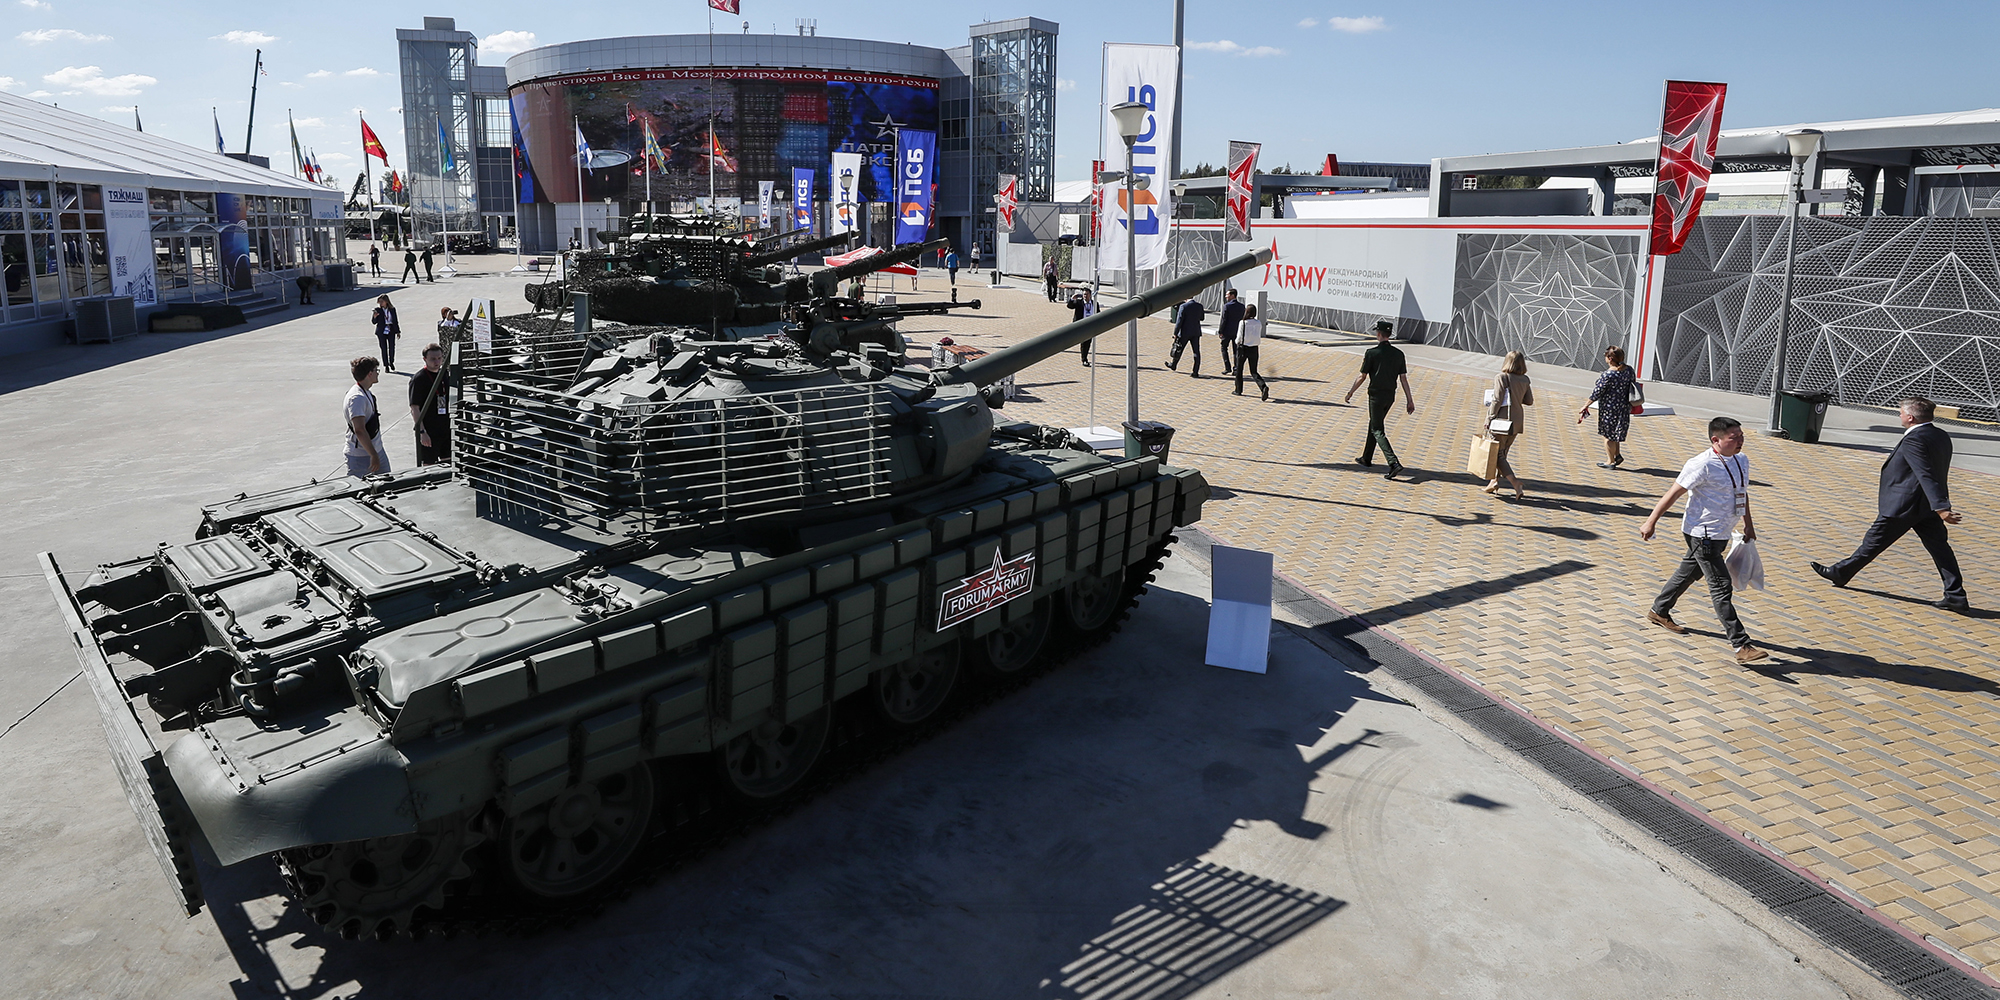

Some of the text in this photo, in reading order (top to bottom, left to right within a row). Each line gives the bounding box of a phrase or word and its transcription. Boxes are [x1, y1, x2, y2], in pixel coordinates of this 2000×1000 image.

[672, 71, 828, 80] Международном
[841, 142, 894, 153] ПАТР
[860, 156, 892, 166] ЭКС
[904, 148, 925, 195] ПСБ
[108, 188, 143, 201] ТЯЖМАШ
[798, 179, 808, 207] ПСБ
[1328, 268, 1389, 279] МЕЖДУНАРОДНЫЙ
[1327, 278, 1402, 291] ВОЕННО-ТЕХНИЧЕСКИЙ
[1327, 288, 1399, 302] ФОРУМ «АРМИЯ-2023»
[951, 587, 991, 614] FORUM
